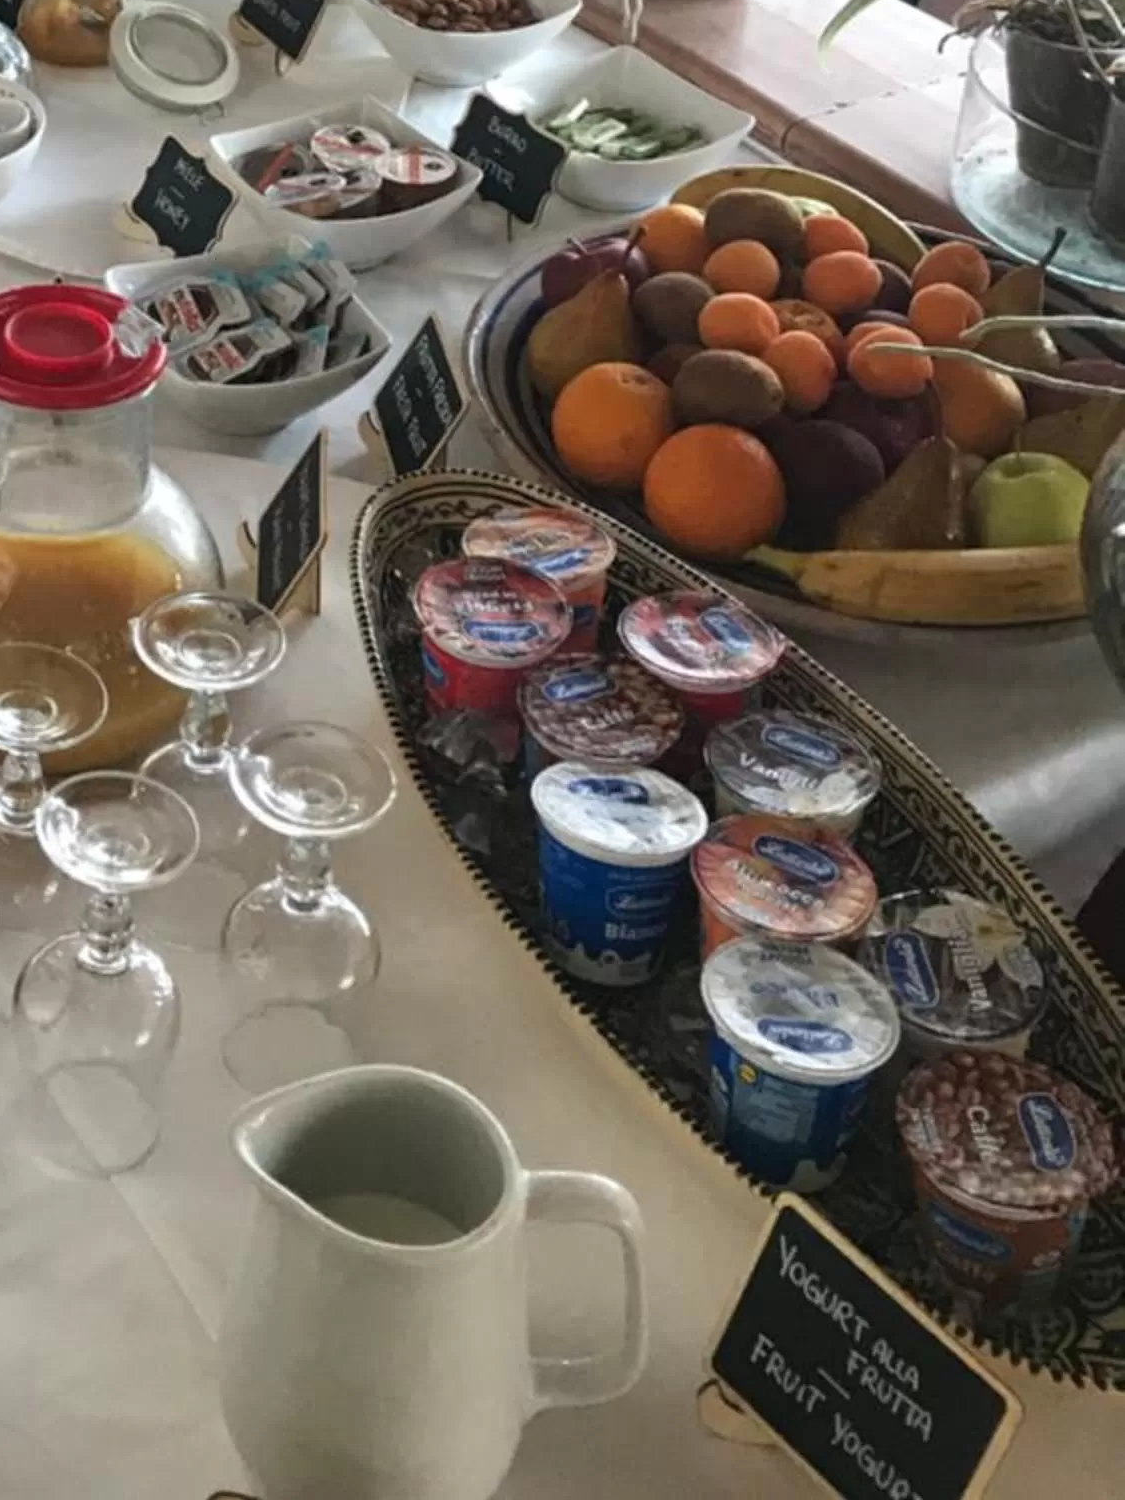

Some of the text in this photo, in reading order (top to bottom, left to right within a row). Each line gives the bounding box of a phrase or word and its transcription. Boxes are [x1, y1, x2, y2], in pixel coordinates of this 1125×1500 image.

[778, 1235, 921, 1392] YOGURT ALLA
[750, 1333, 923, 1500] FRUIT YOGUR
[846, 1349, 933, 1443] FRUTTA
